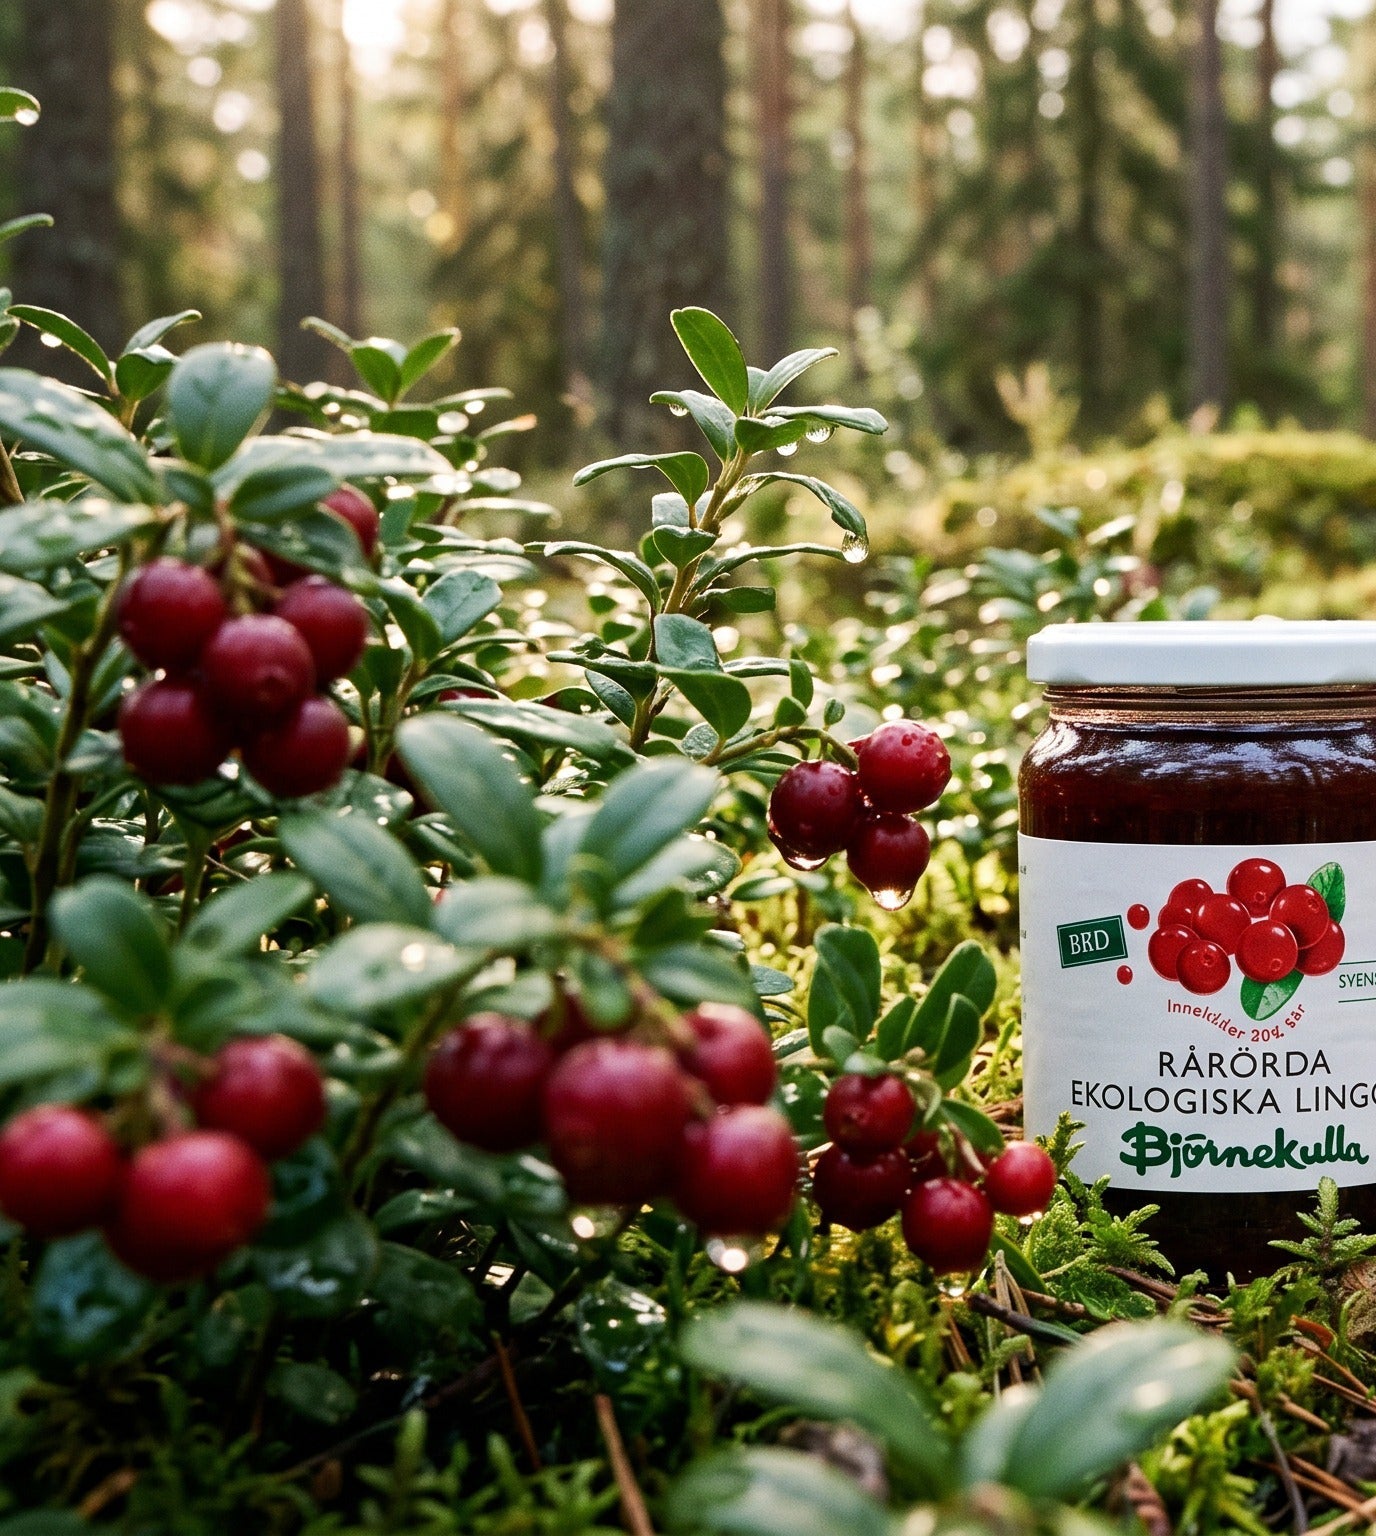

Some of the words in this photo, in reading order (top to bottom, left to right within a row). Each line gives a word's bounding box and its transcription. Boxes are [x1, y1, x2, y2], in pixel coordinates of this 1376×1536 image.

[1069, 929, 1110, 955] BRD
[1159, 1045, 1331, 1079] RÅRÖRDA
[1071, 1079, 1282, 1115] EKOLOGISKA
